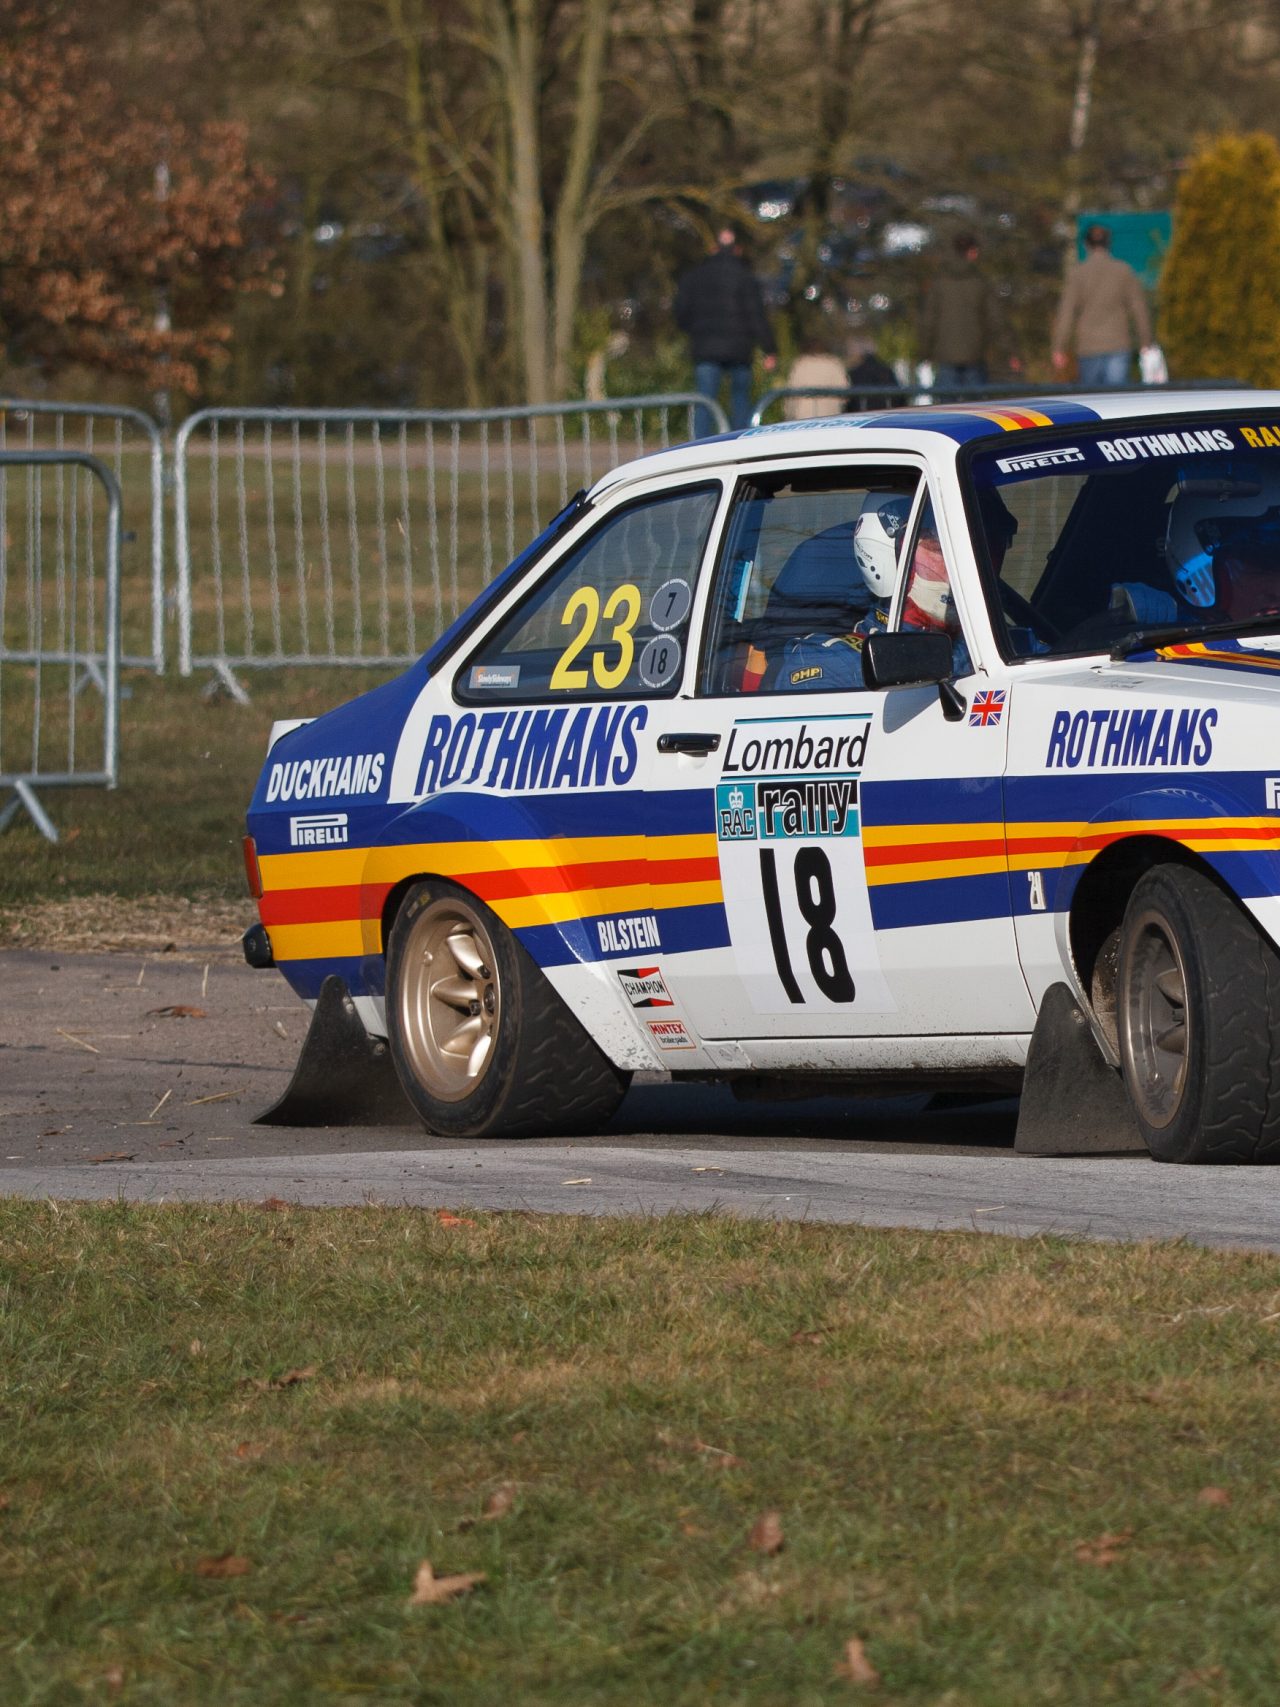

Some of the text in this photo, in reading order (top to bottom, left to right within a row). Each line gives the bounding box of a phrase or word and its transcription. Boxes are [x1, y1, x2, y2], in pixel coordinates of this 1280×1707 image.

[995, 447, 1086, 474] PIRELLI
[1097, 429, 1234, 462] ROTHMANS
[665, 592, 677, 618] 7
[550, 583, 641, 690] 23
[650, 648, 668, 674] 18
[792, 667, 820, 682] OMP
[414, 705, 648, 796] ROTHMANS
[722, 722, 871, 771] Lombard
[1045, 708, 1218, 768] ROTHMANS
[266, 753, 385, 802] DUCKHAMS
[721, 782, 852, 837] RAC rally
[289, 813, 348, 846] PIRELLI
[597, 916, 661, 952] BILSTEIN
[759, 846, 856, 1004] 18
[624, 980, 665, 996] CHAMPION
[651, 1023, 685, 1034] MINTEX
